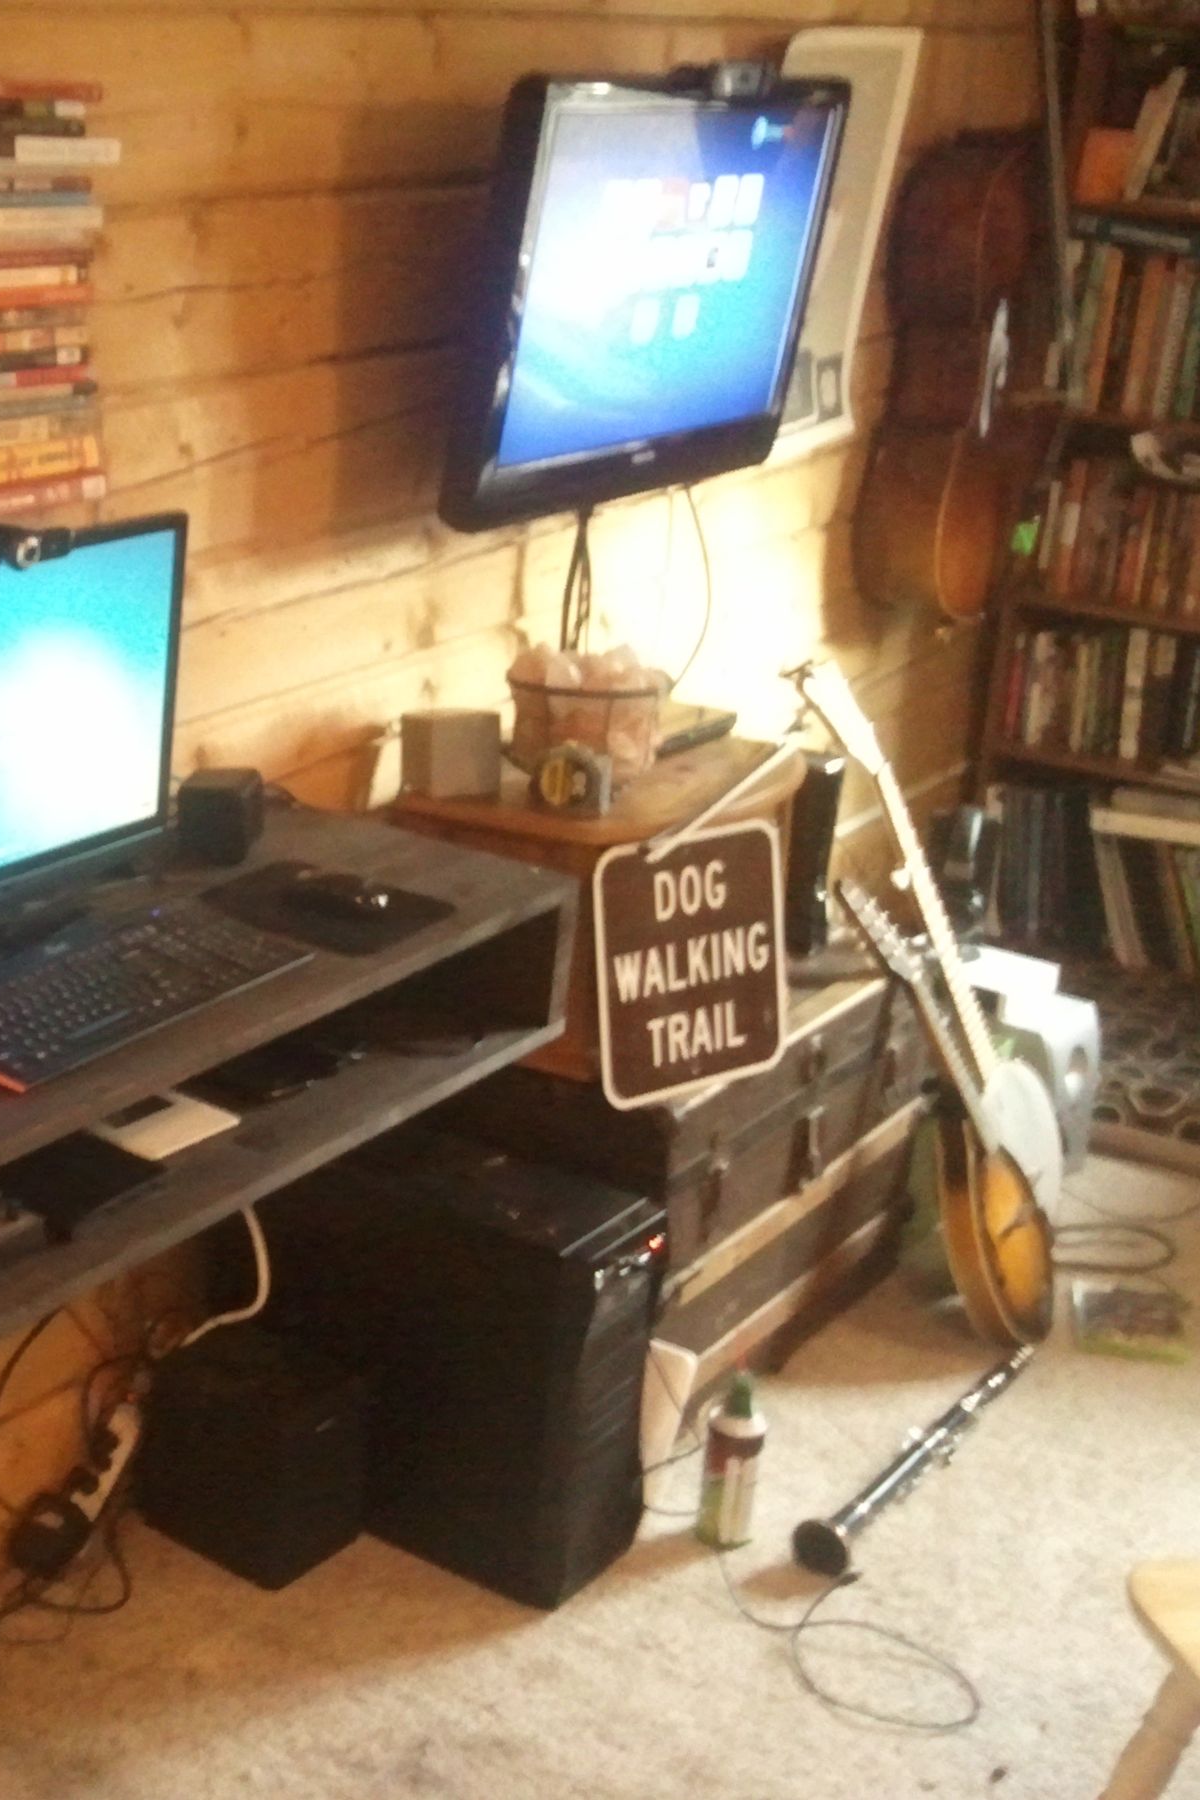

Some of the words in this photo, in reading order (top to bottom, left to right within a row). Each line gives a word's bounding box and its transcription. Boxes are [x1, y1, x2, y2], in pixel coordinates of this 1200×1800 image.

[653, 859, 728, 922] DOG
[613, 921, 770, 1004] WALKING
[646, 1000, 748, 1068] TRAIL
